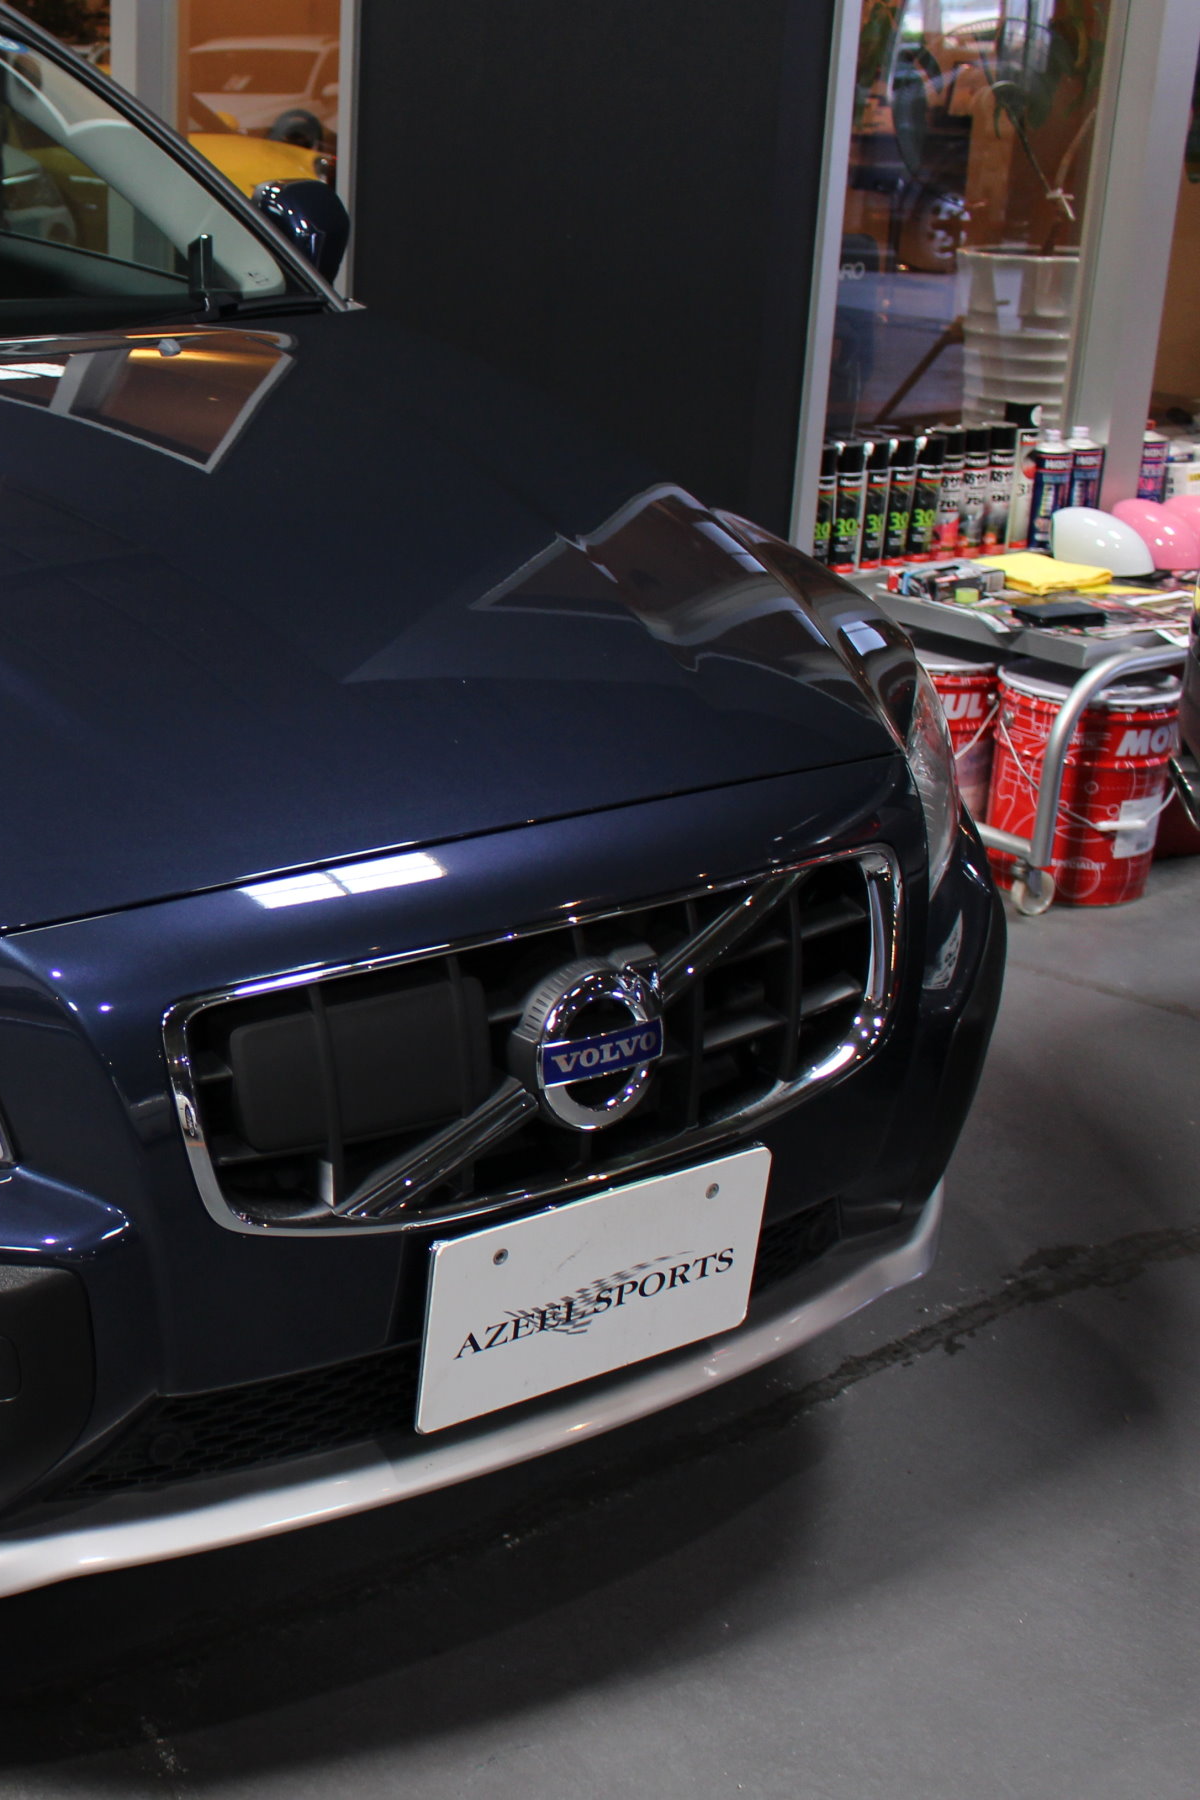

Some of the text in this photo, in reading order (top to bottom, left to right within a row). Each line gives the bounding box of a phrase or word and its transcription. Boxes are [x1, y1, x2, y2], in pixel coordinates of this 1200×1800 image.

[938, 693, 983, 720] UL
[550, 1031, 657, 1073] VOLVO
[593, 1247, 735, 1315] SPORTS
